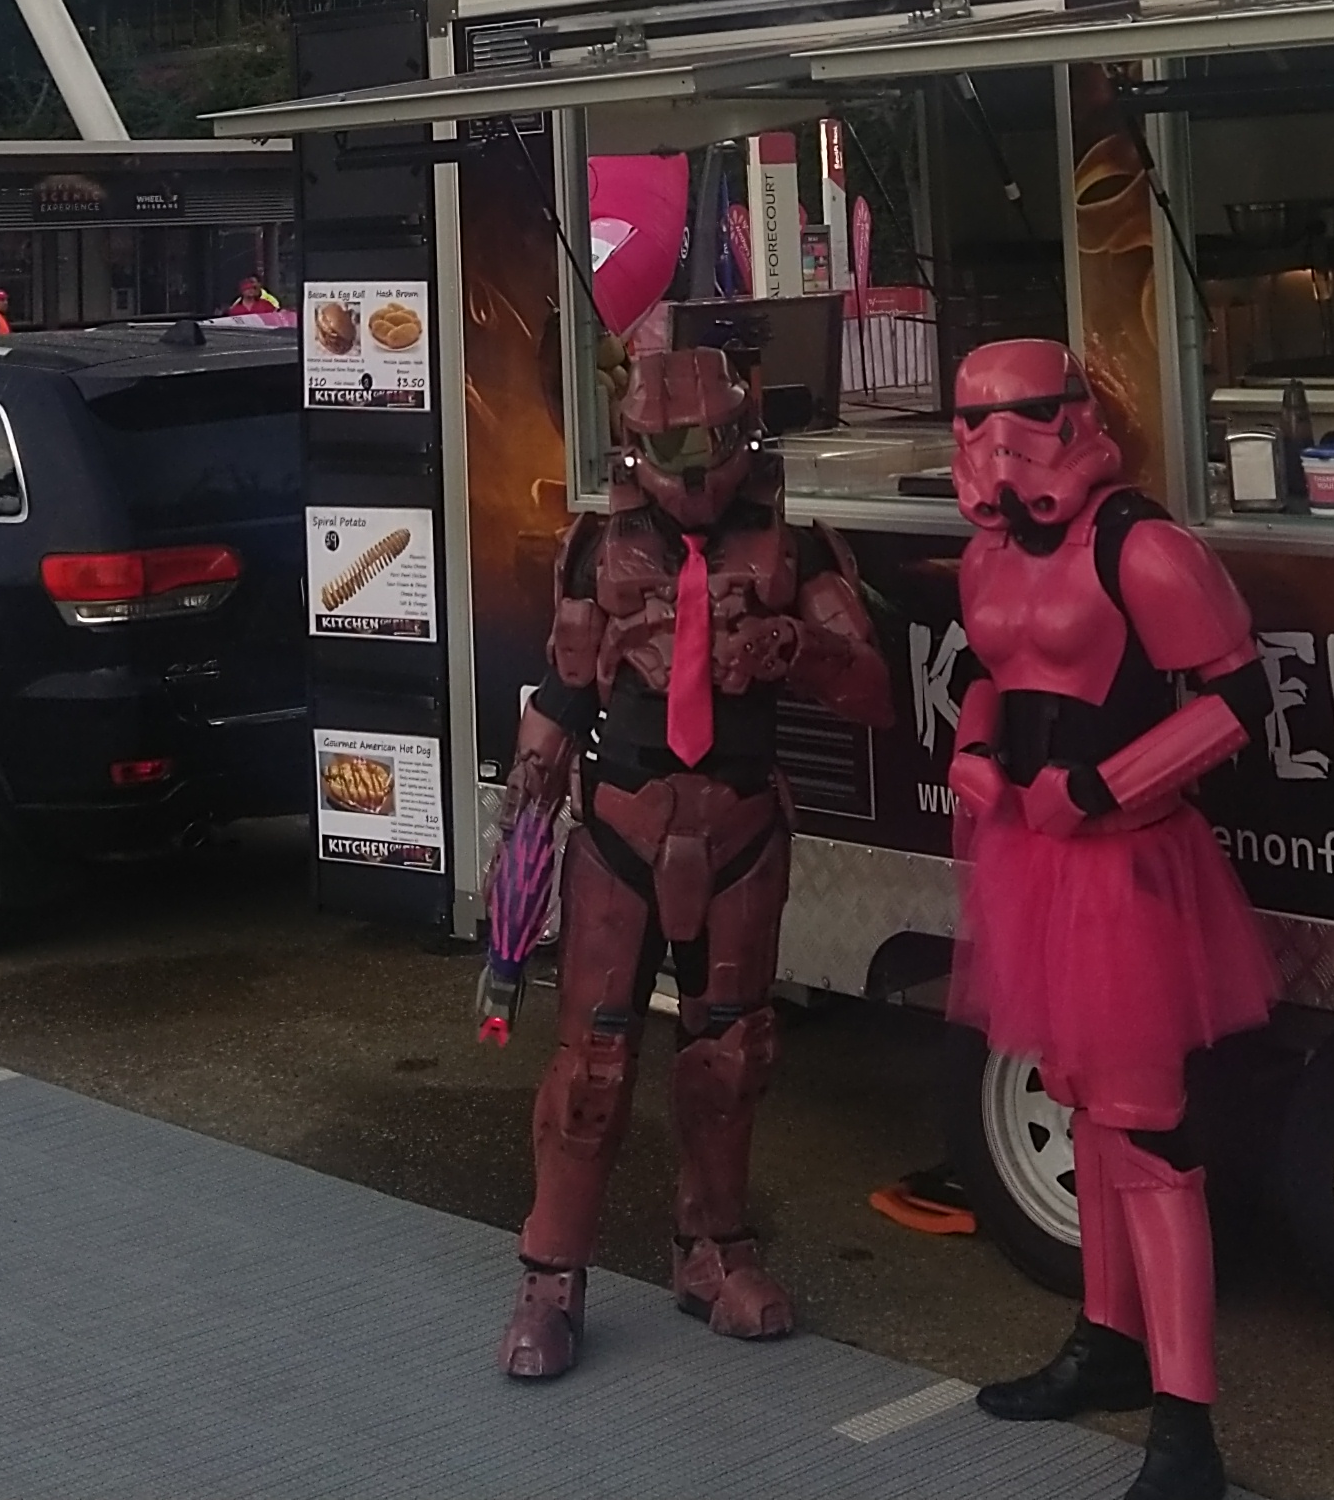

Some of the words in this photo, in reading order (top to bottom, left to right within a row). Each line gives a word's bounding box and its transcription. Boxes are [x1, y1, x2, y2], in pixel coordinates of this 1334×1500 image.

[136, 194, 164, 203] WHEEL
[40, 203, 100, 212] EXPERIENCE
[765, 173, 779, 277] FORECOURT
[308, 376, 327, 388] $10
[397, 377, 425, 389] $3.50
[315, 390, 372, 403] KITCHEN
[313, 516, 337, 529] Spiral
[339, 517, 367, 528] Potato
[321, 617, 379, 630] KITCHEN
[323, 737, 357, 749] Gourmet
[359, 740, 396, 752] American
[399, 744, 413, 754] Hot
[416, 746, 431, 758] Dog
[425, 814, 439, 824] $10
[329, 838, 389, 857] KITCHEN
